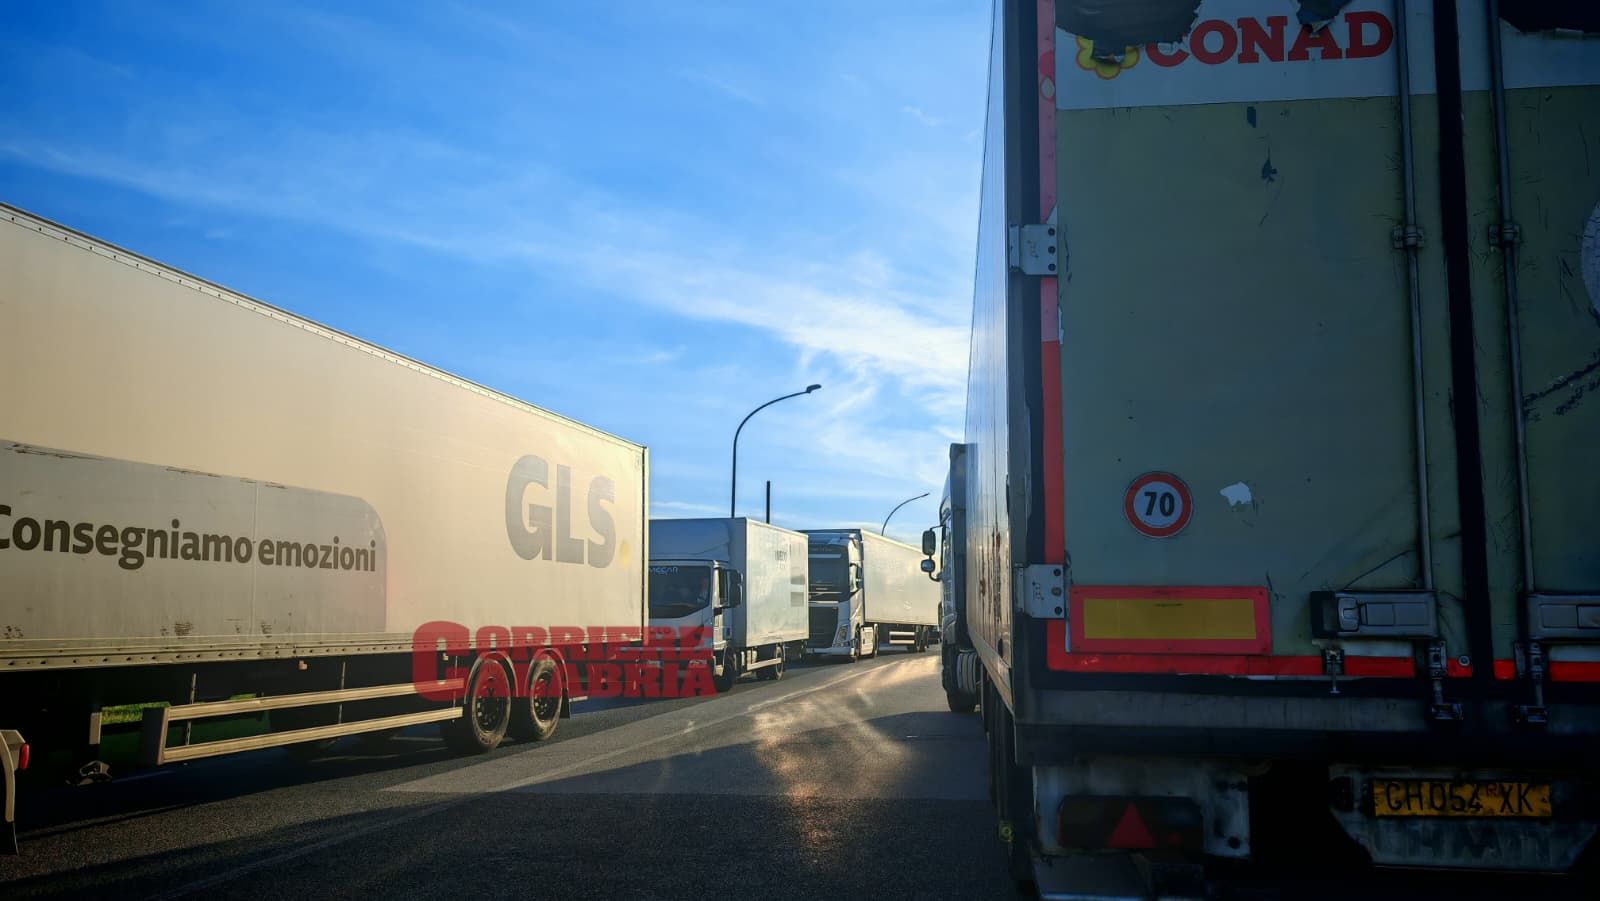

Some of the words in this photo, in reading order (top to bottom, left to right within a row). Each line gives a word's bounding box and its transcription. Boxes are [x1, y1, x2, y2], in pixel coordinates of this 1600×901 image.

[505, 454, 617, 569] GLS
[1144, 491, 1176, 517] 70
[258, 535, 376, 572] emozioni
